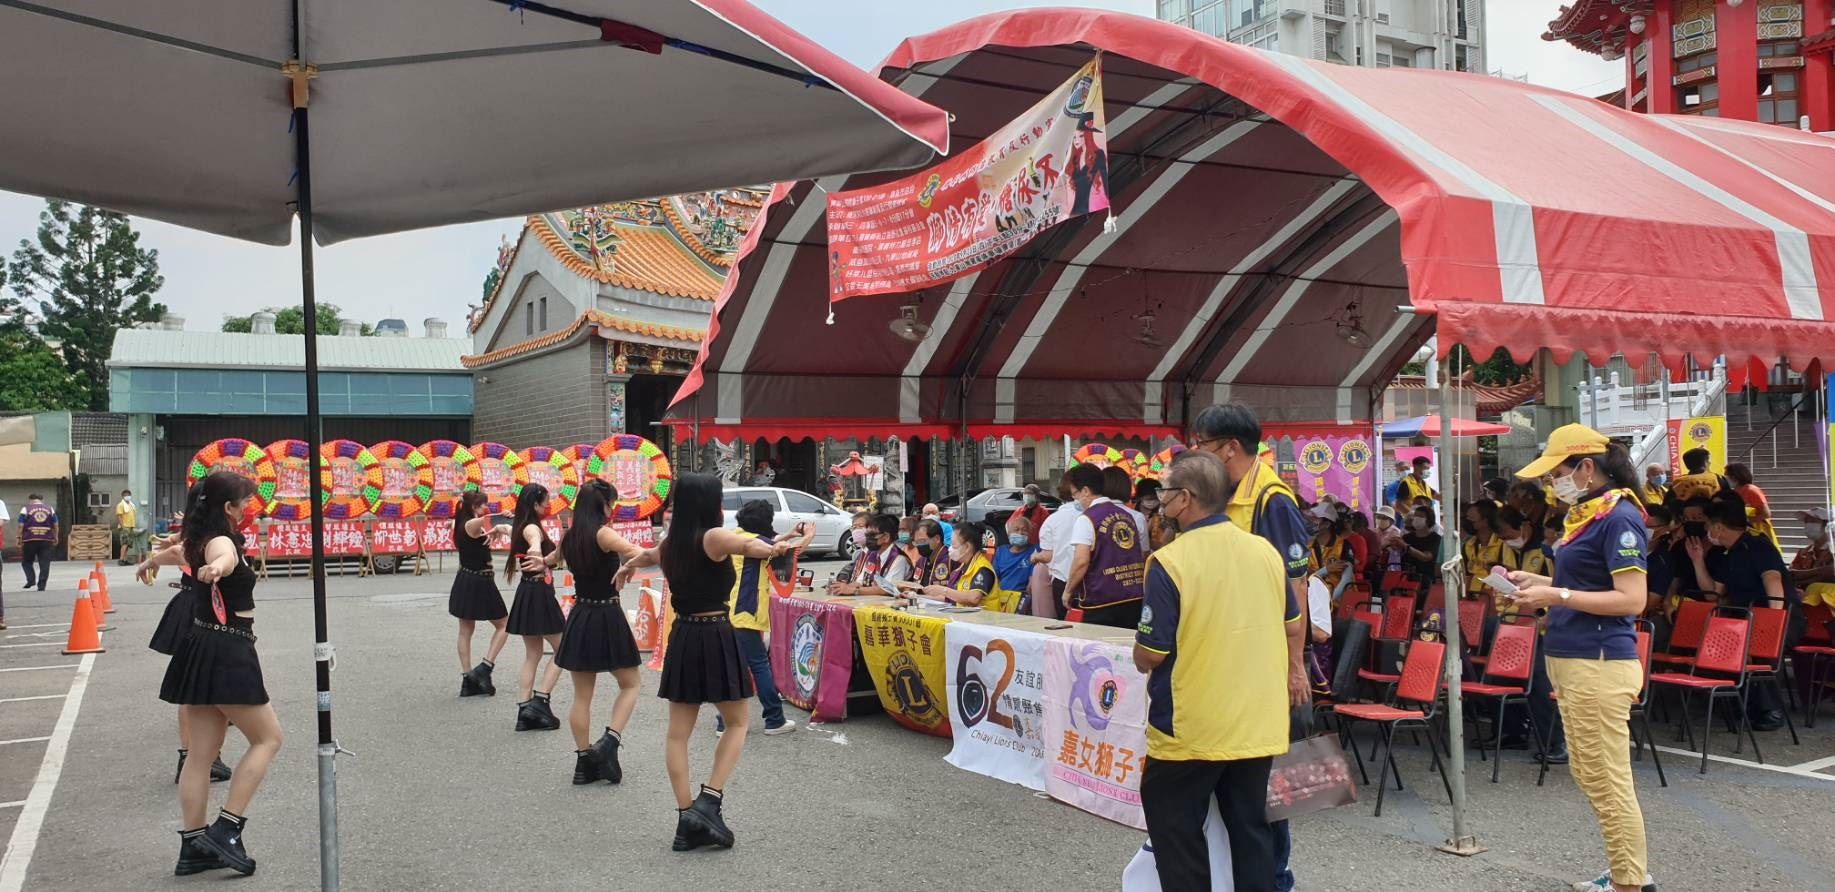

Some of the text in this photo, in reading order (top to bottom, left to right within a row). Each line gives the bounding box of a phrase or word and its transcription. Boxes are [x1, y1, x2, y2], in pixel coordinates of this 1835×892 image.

[956, 638, 1016, 729] 62
[970, 729, 993, 745] Chiayi
[993, 735, 1013, 749] Lions
[1012, 740, 1026, 753] Club
